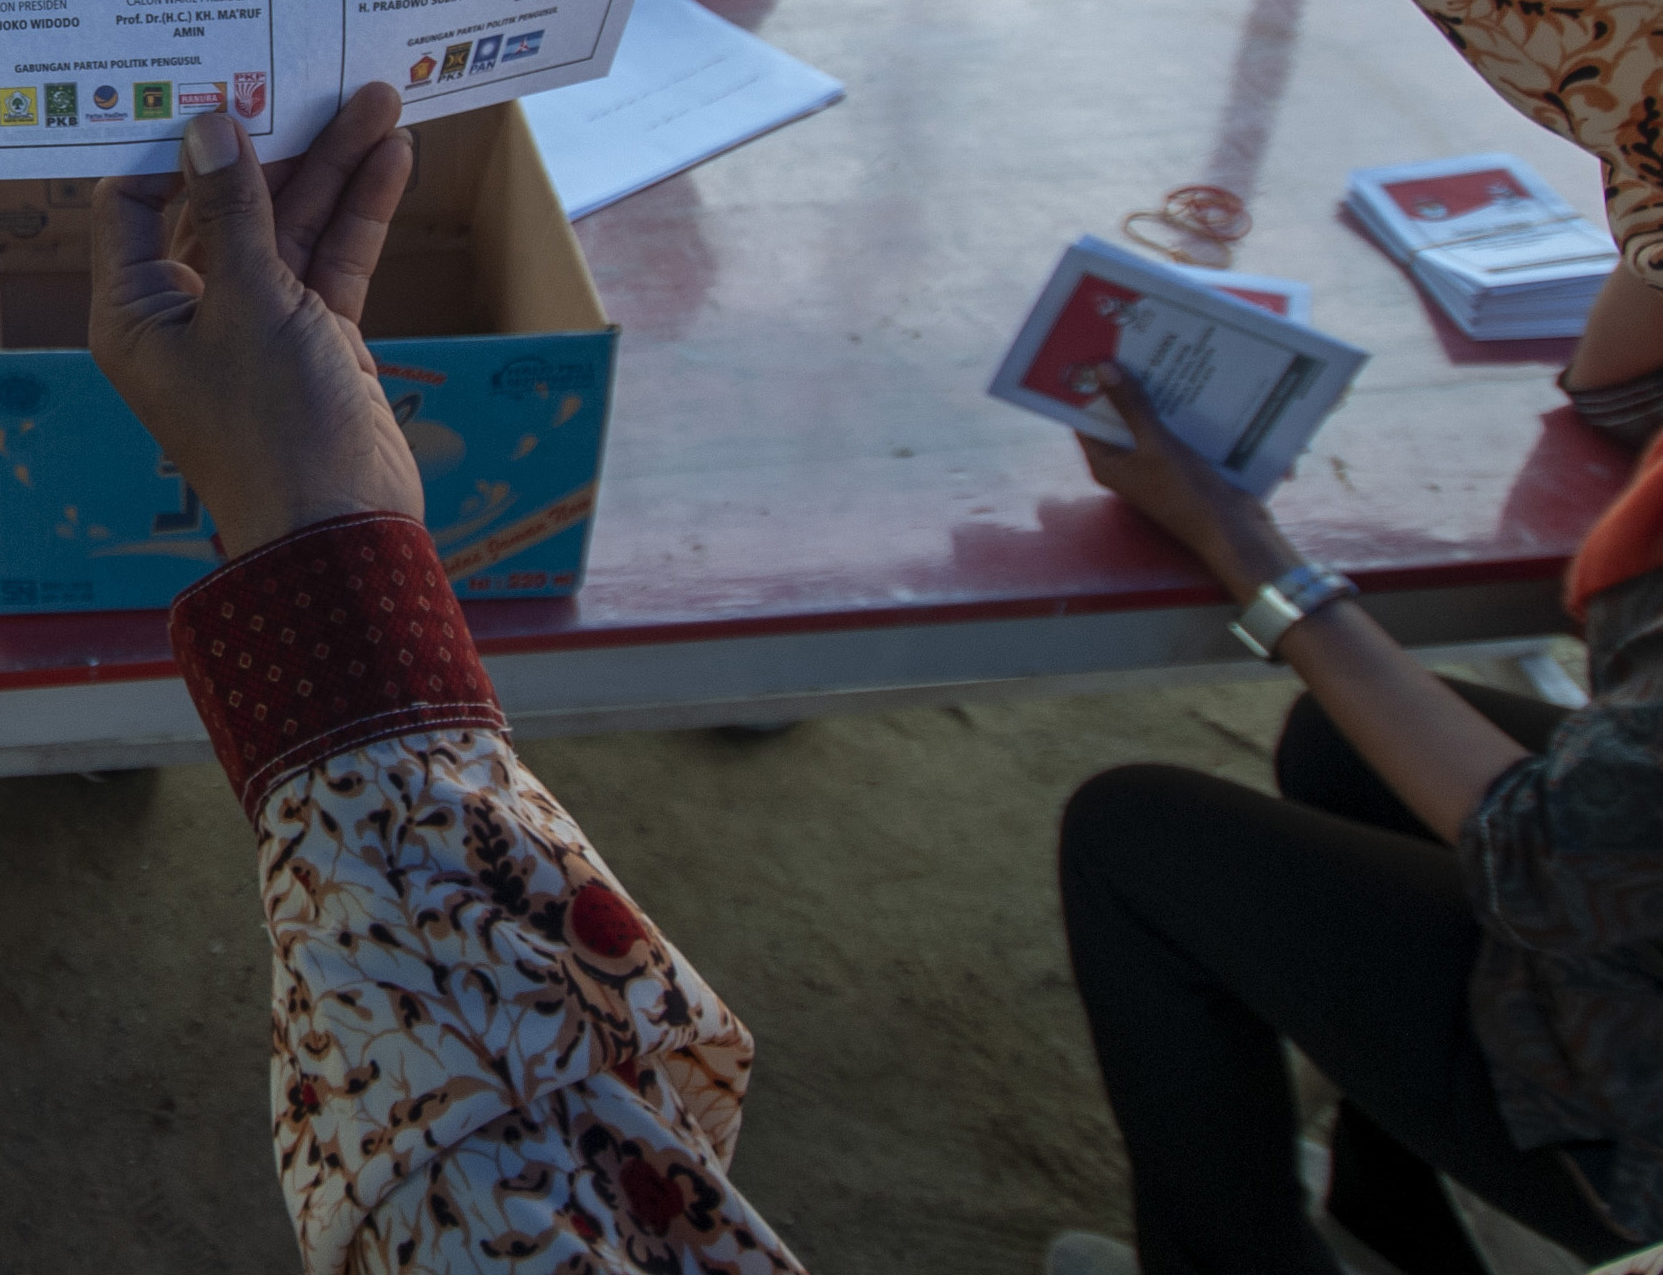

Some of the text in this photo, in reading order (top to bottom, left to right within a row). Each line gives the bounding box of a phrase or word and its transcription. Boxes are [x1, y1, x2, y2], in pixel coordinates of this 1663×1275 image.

[358, 0, 370, 13] H.
[29, 16, 81, 31] WIDODO
[115, 12, 144, 27] Prof.
[195, 9, 216, 23] KH.
[173, 25, 205, 39] AMIN
[14, 55, 202, 74] GABUNGAN PARTAI POLITIK PENGUSUL
[469, 60, 496, 75] PAN
[181, 93, 219, 103] HANURA
[46, 116, 79, 128] PKB
